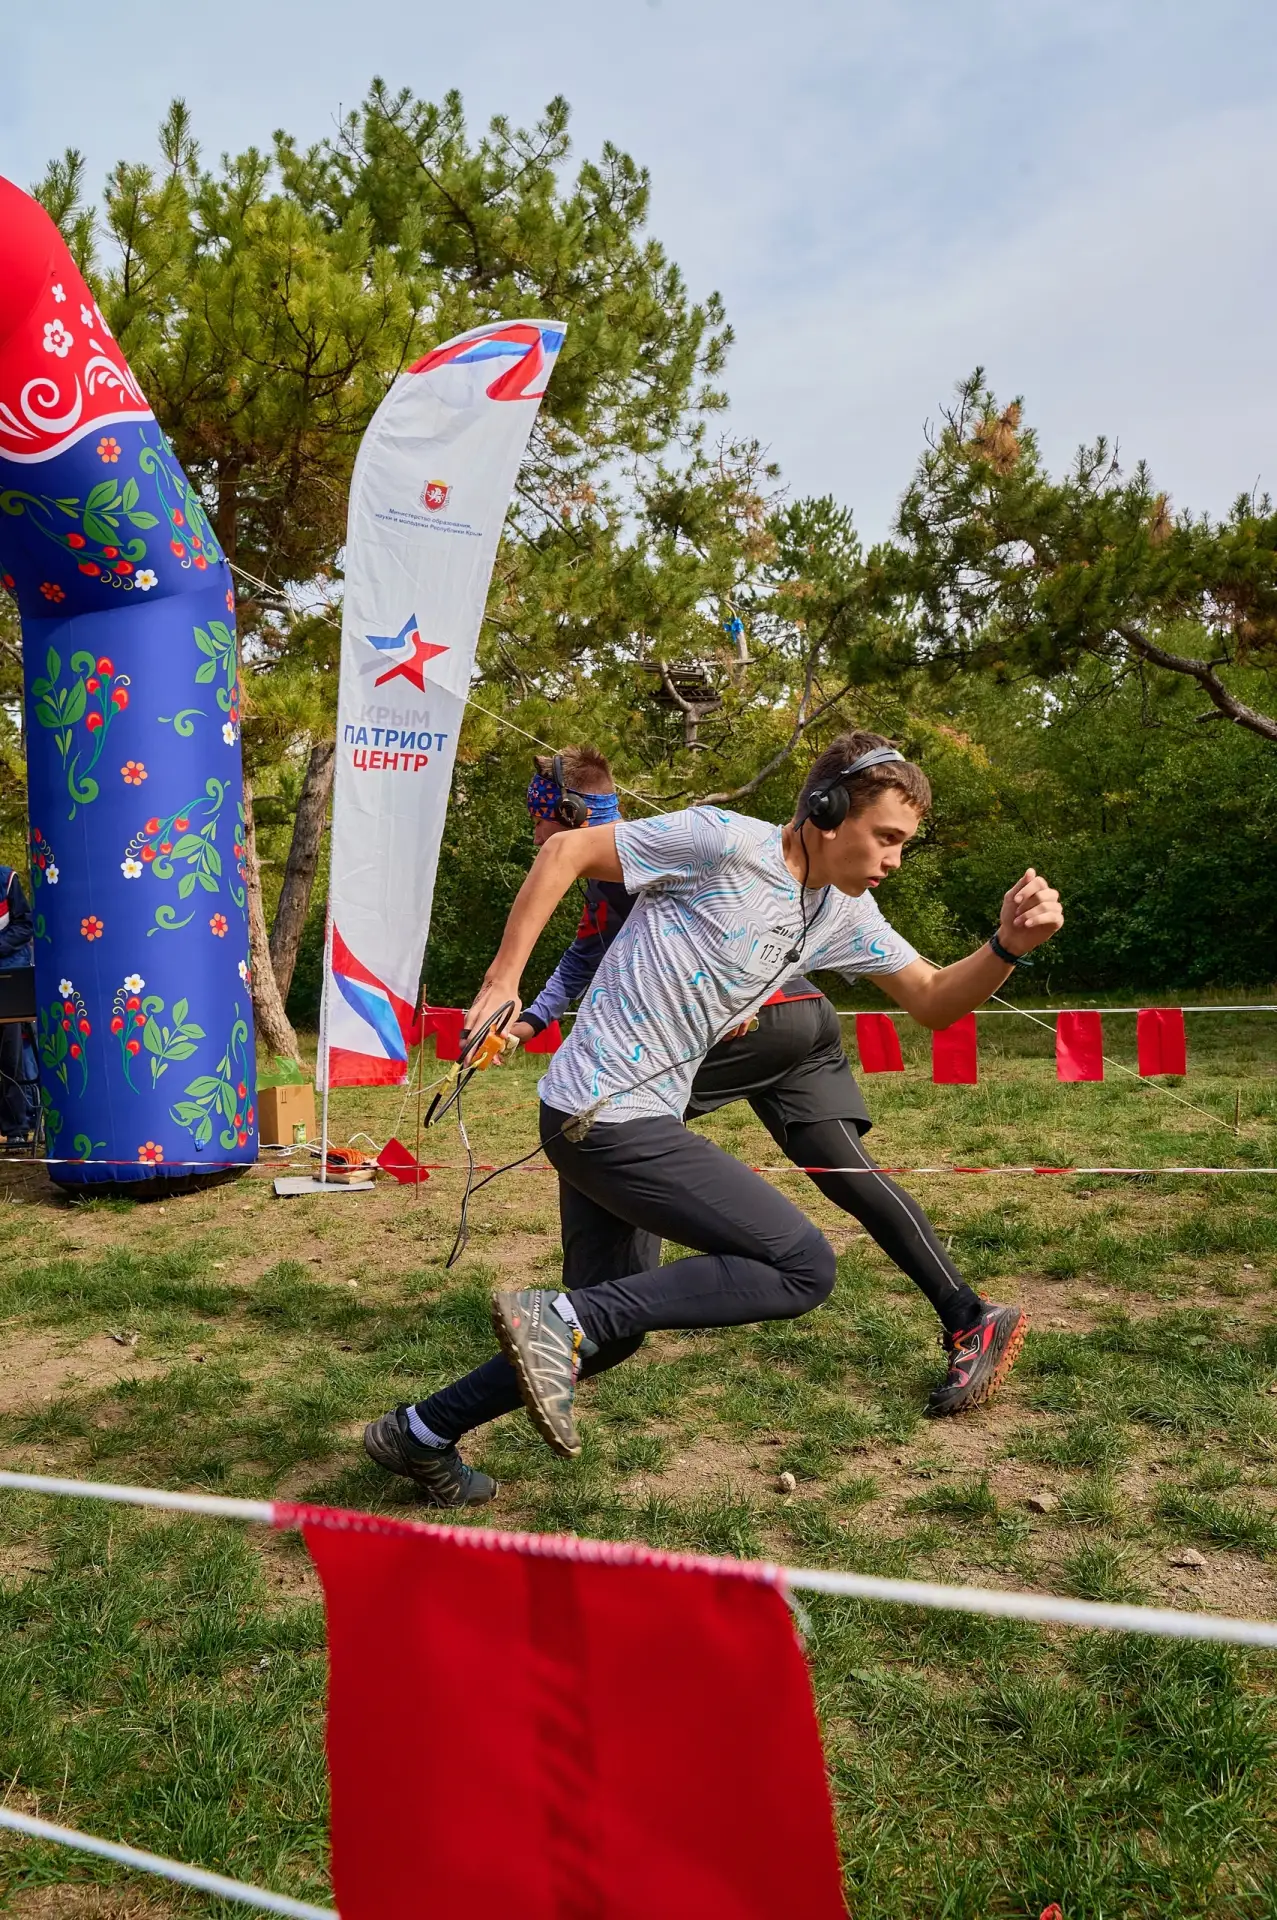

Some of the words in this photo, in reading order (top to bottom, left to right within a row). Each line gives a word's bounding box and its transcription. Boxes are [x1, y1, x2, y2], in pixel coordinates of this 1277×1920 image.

[375, 513, 392, 521] науки
[430, 523, 465, 534] Республики
[389, 508, 431, 521] Министерство
[359, 703, 431, 729] КРЫМ
[344, 724, 448, 752] ПАТРИОТ
[353, 749, 429, 772] ЦЕНТР
